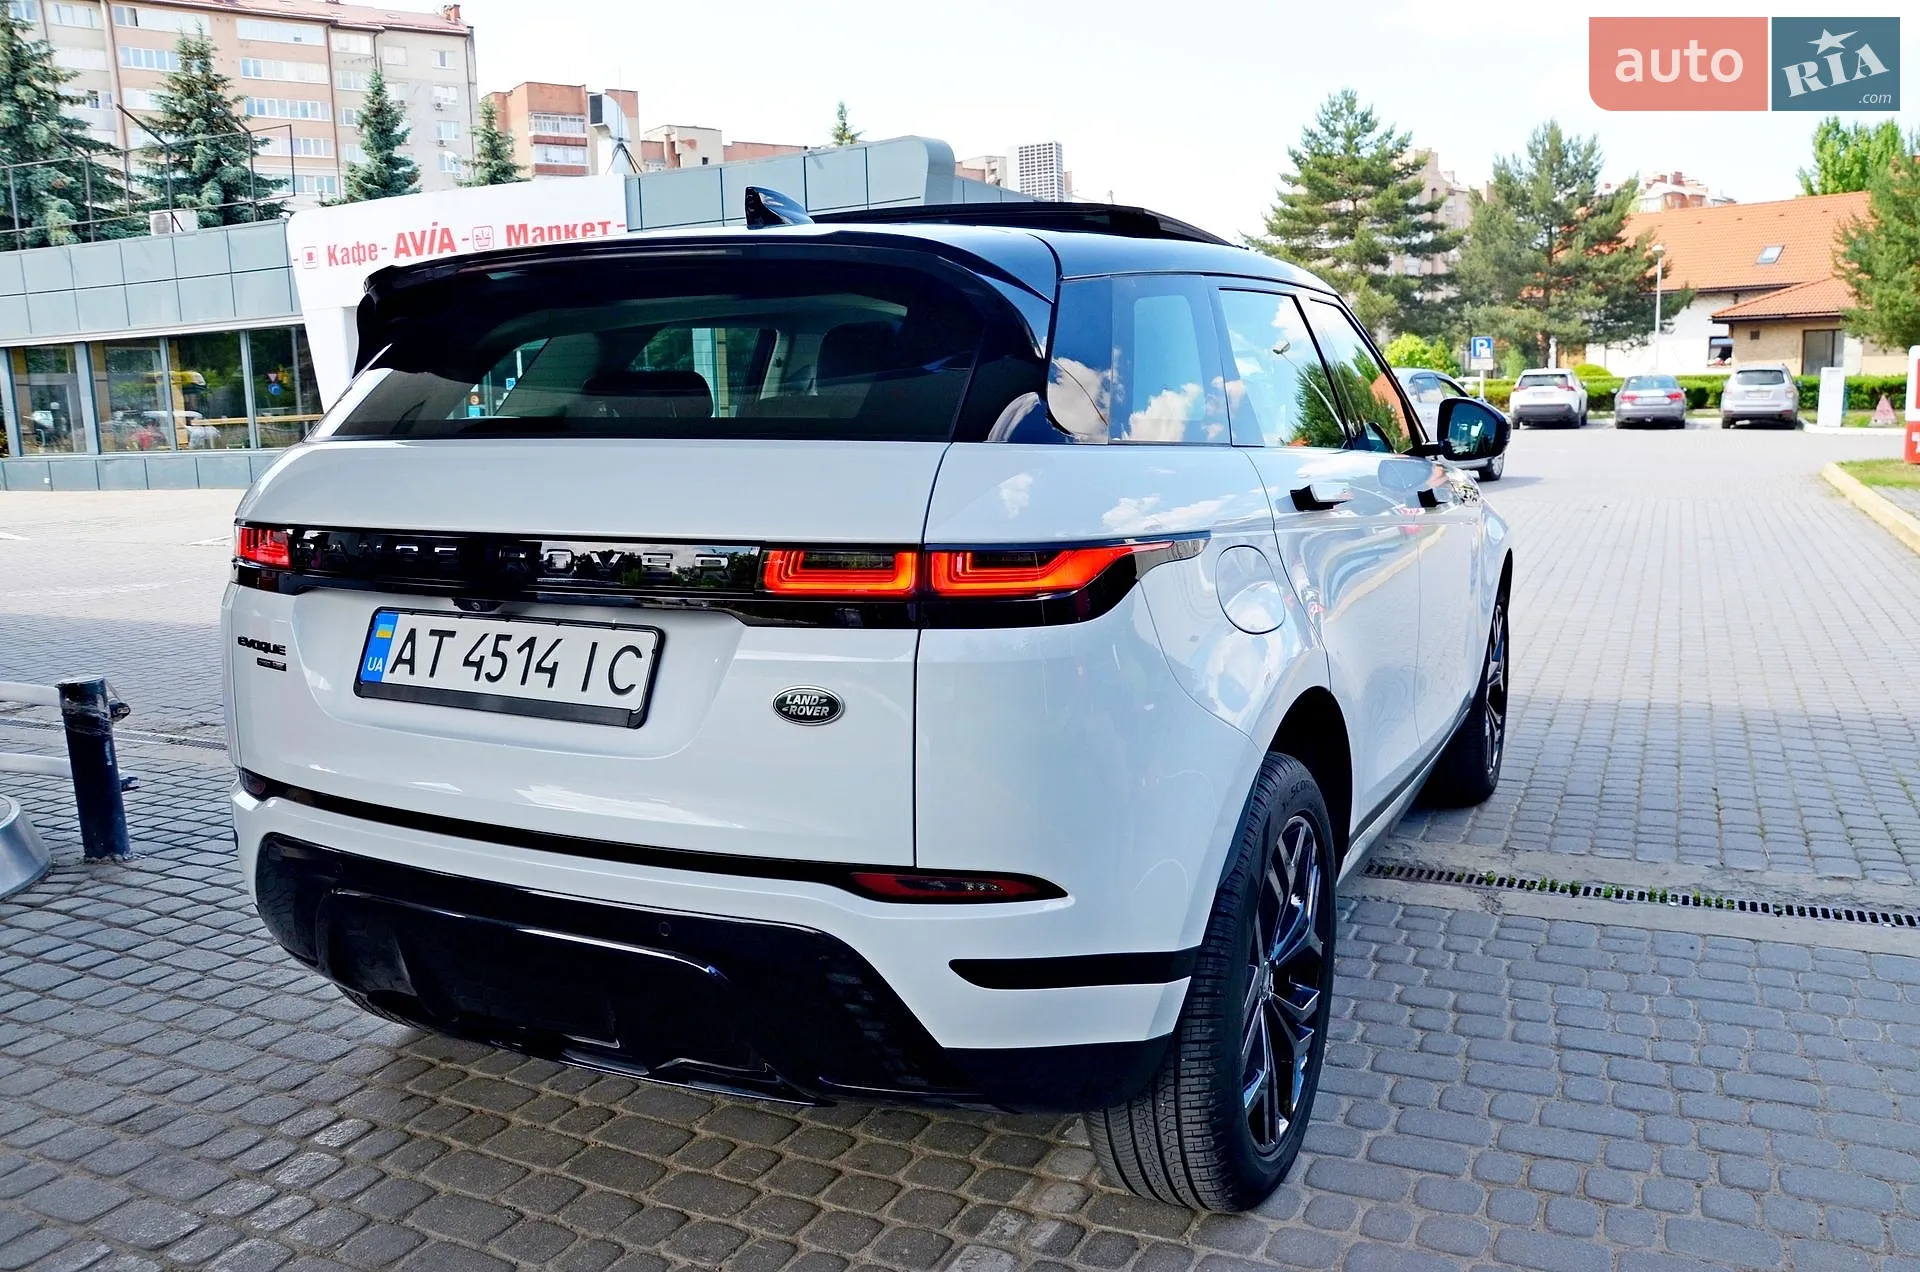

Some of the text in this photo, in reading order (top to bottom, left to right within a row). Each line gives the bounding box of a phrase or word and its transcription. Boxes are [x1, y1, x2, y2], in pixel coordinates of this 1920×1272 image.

[327, 241, 378, 266] Кафе
[367, 656, 383, 673] UA
[389, 627, 643, 696] AT 4514 IC
[785, 694, 820, 706] LAND
[788, 705, 830, 717] ROVER
